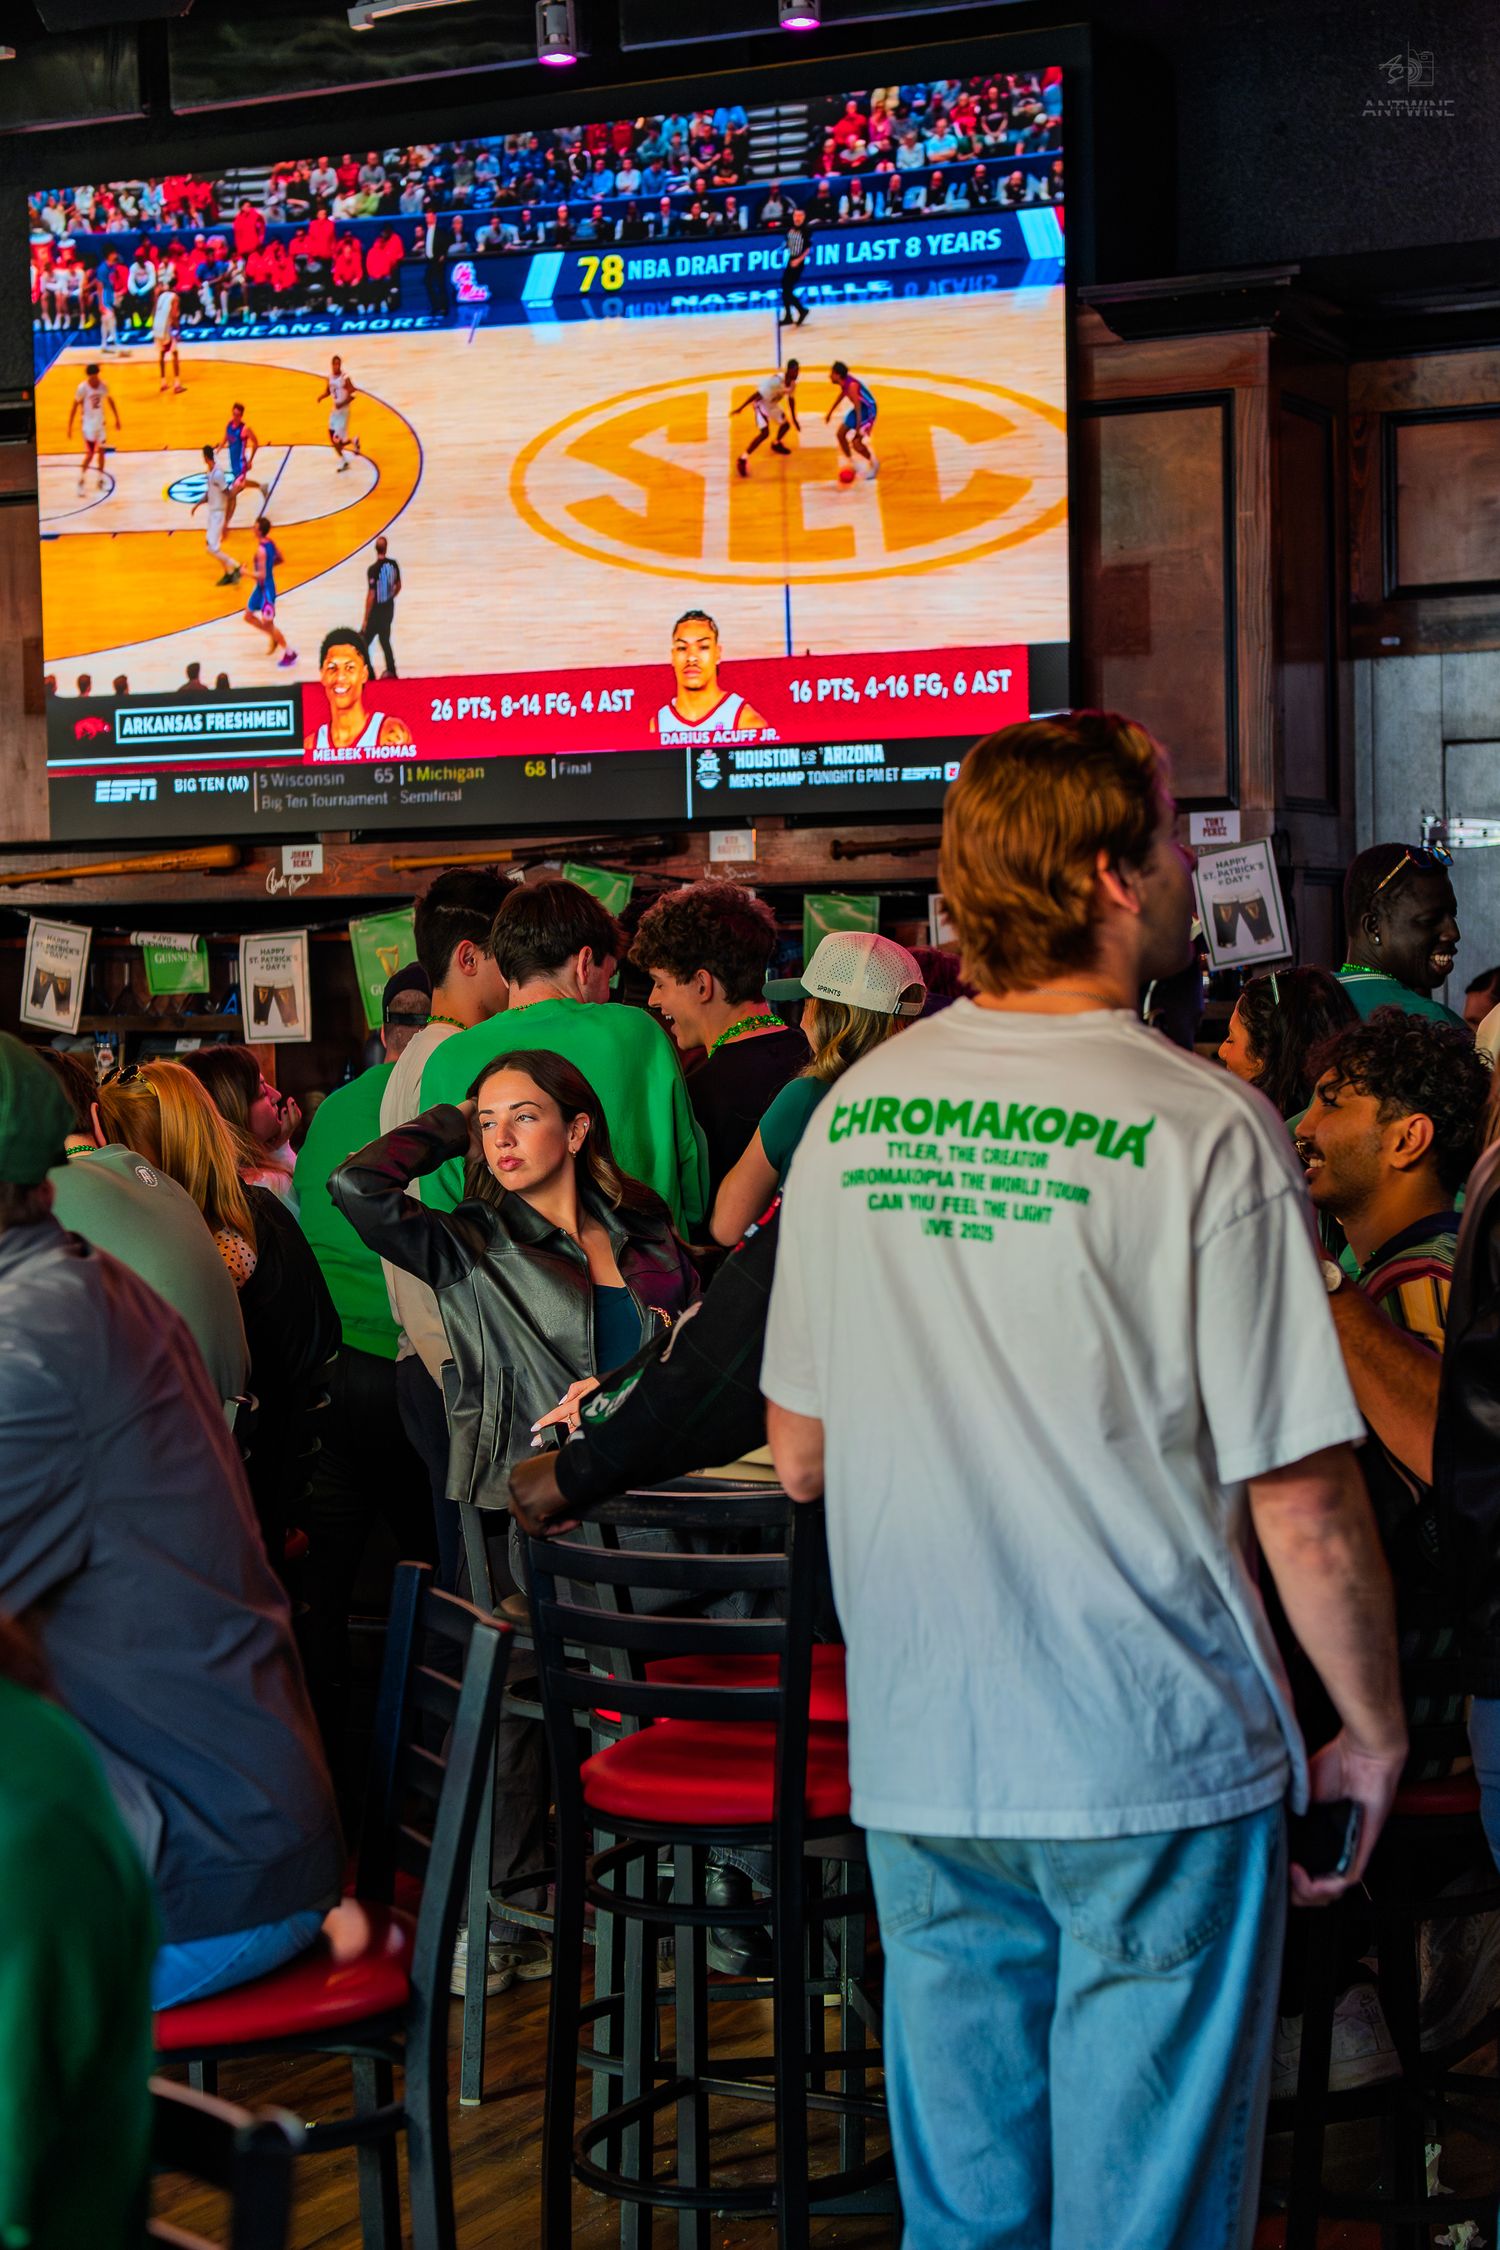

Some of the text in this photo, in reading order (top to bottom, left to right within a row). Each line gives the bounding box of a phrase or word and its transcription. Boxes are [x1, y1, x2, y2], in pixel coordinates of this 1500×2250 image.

[577, 254, 624, 293] 78
[628, 259, 670, 281] NBA
[675, 252, 744, 276] DRAFT
[816, 243, 840, 266] IN
[846, 237, 901, 263] LAST
[904, 236, 922, 258] 8
[928, 228, 1002, 254] YEARS
[222, 322, 331, 338] MEANS
[563, 380, 1034, 563] SEC
[789, 669, 1012, 704] 16 PTS, 4-16 FG, 6 AST
[430, 689, 635, 722] 26 PTS, 8-14 FG, 4 AST
[122, 709, 289, 735] ARKANSAS FRESHMEN
[660, 727, 781, 746] DARIUS ACUFF JR.
[313, 744, 418, 762] MELEEK THOMAS
[734, 748, 800, 769] HOUSTON
[823, 744, 886, 766] ARIZONA
[259, 767, 395, 789] 5 Wisconsin 65
[416, 766, 486, 783] Michigan
[524, 760, 547, 777] 68
[559, 761, 592, 775] Final
[728, 772, 765, 789] MEN'S
[765, 770, 806, 786] CHAMP
[807, 769, 855, 785] TONIGHT
[856, 769, 866, 783] 6
[866, 768, 885, 782] PM
[885, 767, 900, 781] ET
[901, 766, 942, 781] ESPN
[95, 778, 158, 803] ESPN
[173, 775, 249, 794] BIG TEN (M)
[261, 788, 463, 812] Big Ten Tournament Semifinal
[1202, 861, 1265, 882] ST. PATRICK'S
[1215, 856, 1248, 869] HAPPY
[1225, 876, 1244, 886] DAY
[260, 947, 286, 955] HAPPY
[817, 984, 842, 997] SPRINTS
[829, 1096, 1157, 1169] CHROMAKOPIA
[886, 1141, 1050, 1170] TYLER, THE CREATOR
[841, 1167, 1091, 1206] CHROMAKOPIA THE WORLD TOUR
[867, 1192, 1054, 1225] CAN YOU FEEL THE LIGHT
